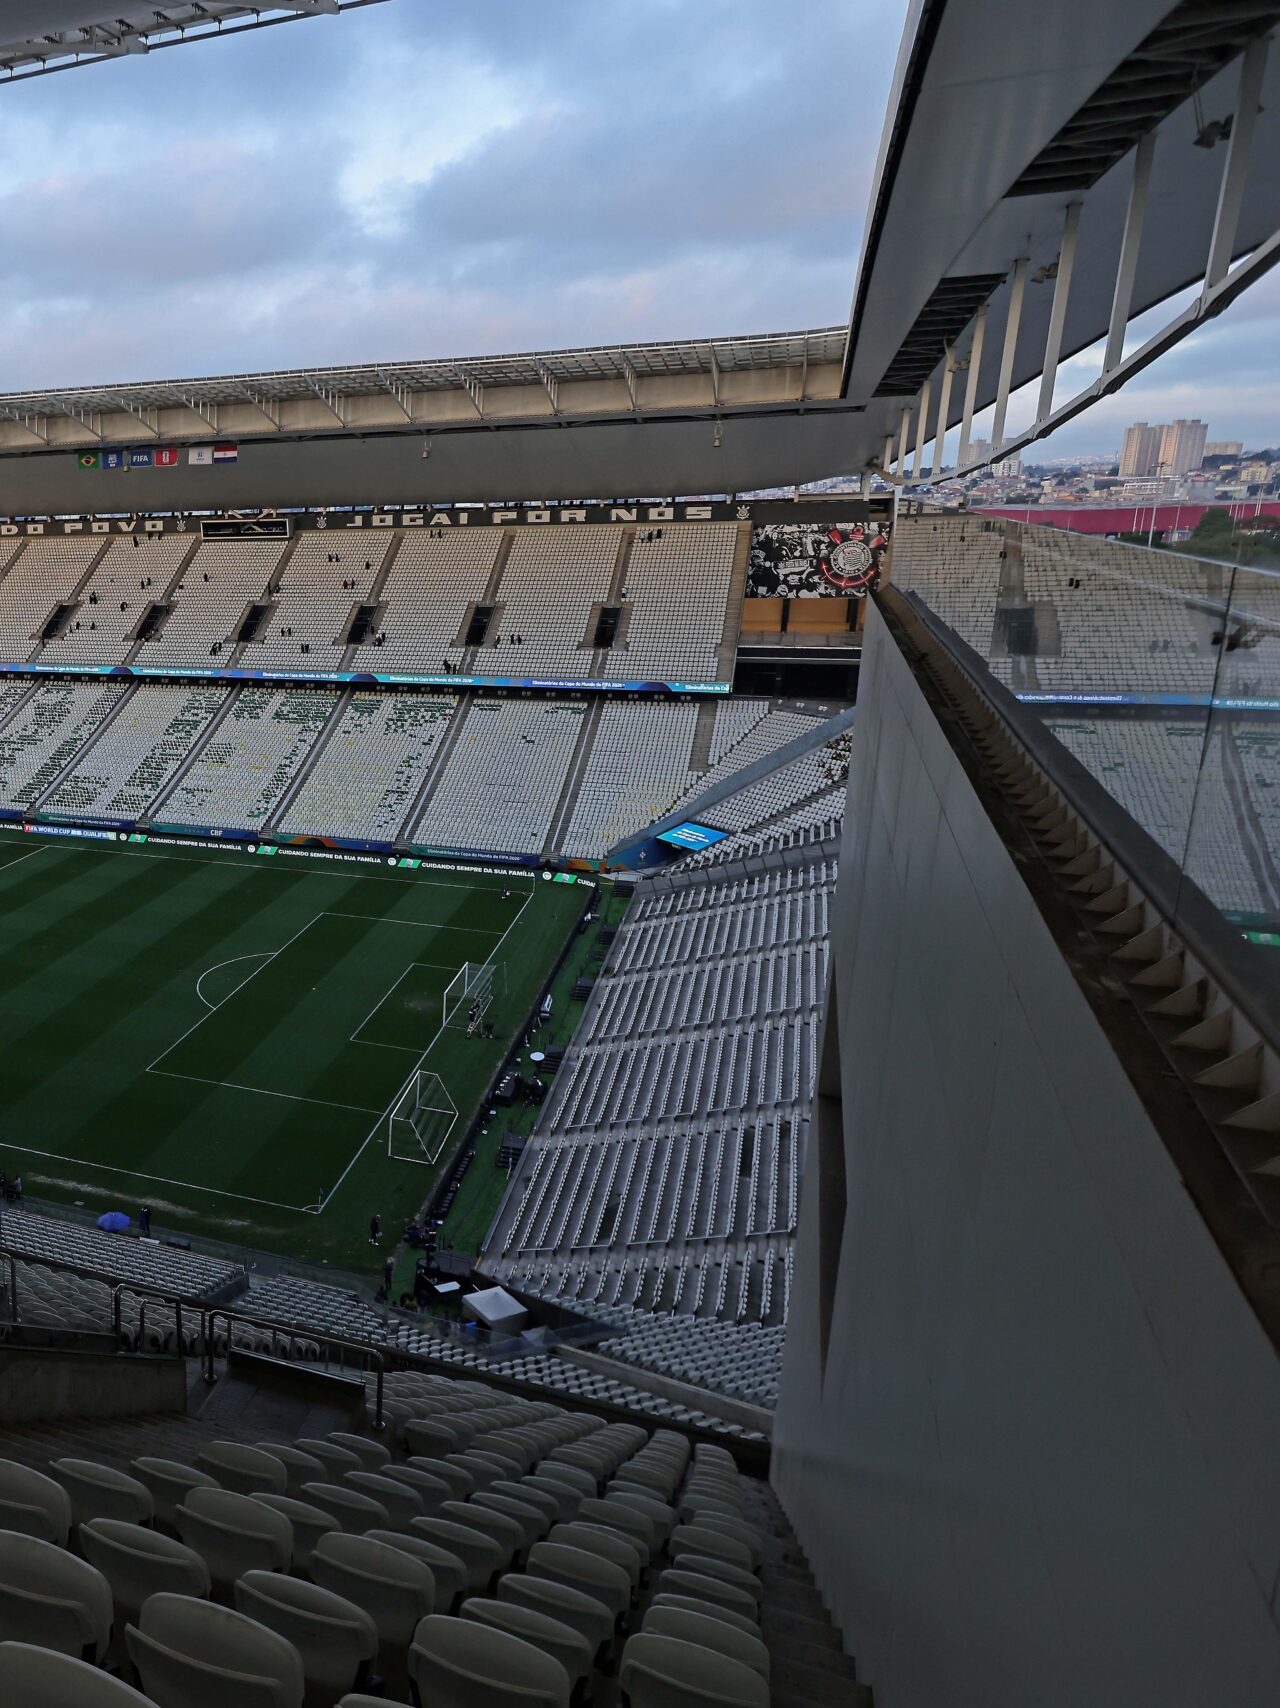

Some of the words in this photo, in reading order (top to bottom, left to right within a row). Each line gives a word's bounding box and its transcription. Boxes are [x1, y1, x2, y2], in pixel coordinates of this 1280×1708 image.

[346, 512, 468, 527] JOGAI
[493, 508, 586, 524] POR
[1, 523, 44, 535] DO
[64, 520, 163, 533] POVO
[278, 849, 309, 857] CUIDANDO
[422, 862, 455, 871] CUIDANDO
[456, 865, 482, 873] SEMPRE
[508, 869, 535, 877] FAMÍLIA
[577, 877, 595, 888] CUIDA
